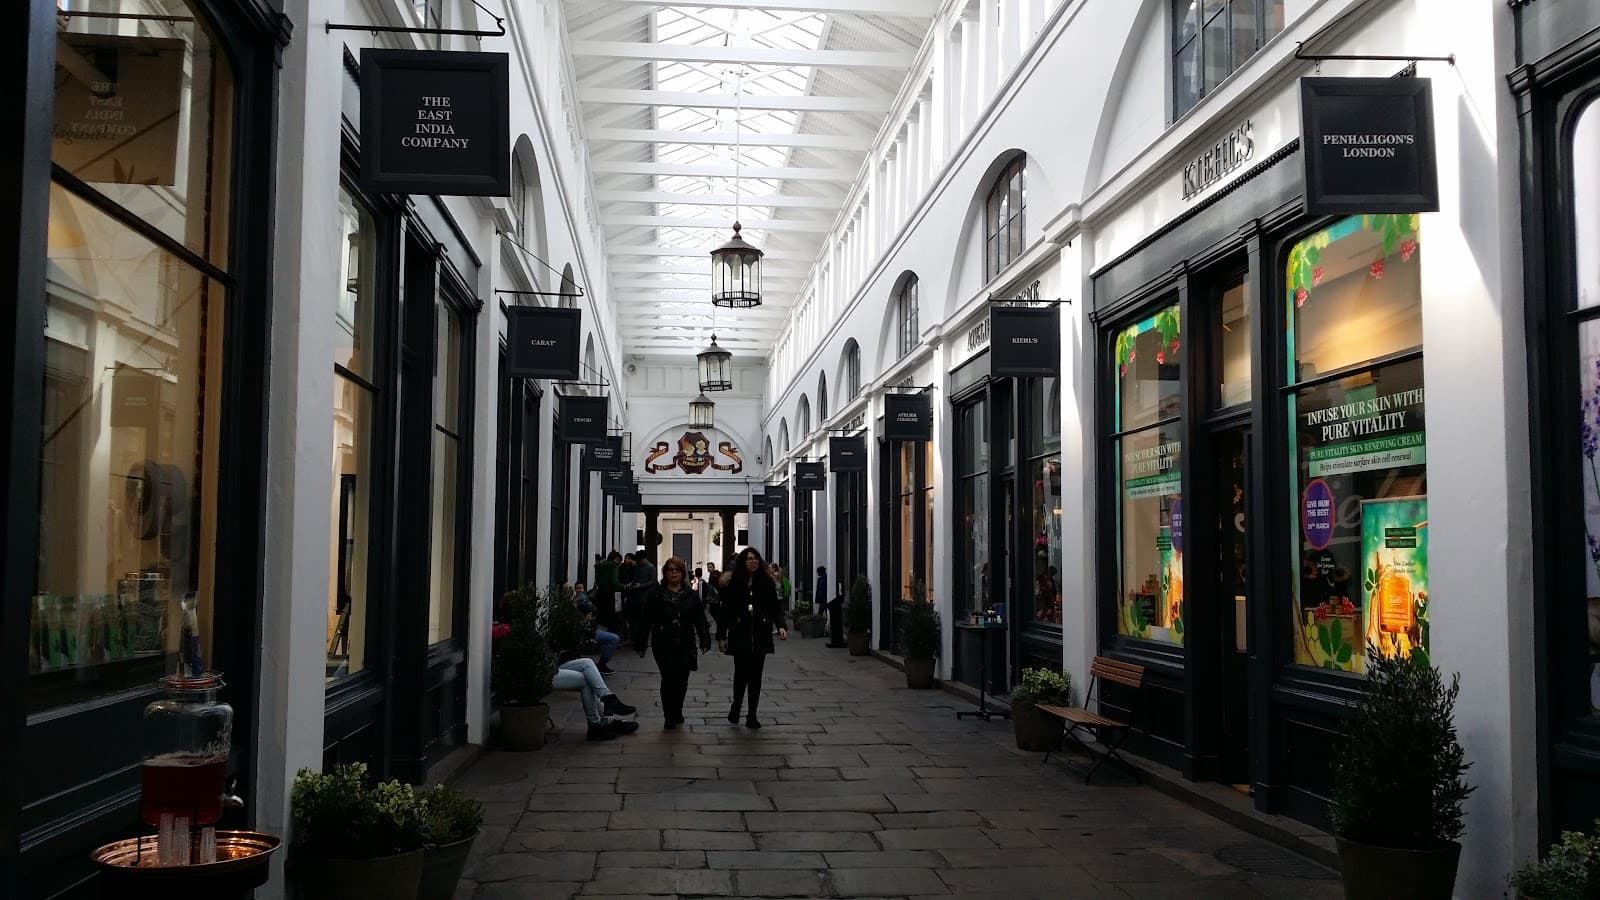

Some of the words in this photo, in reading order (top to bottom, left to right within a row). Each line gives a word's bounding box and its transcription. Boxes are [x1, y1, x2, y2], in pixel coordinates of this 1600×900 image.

[422, 96, 451, 107] THE
[417, 109, 453, 121] EAST
[415, 123, 456, 135] INDIA
[401, 136, 470, 149] COMPANY
[1322, 134, 1415, 145] PENHALIGON'S
[1343, 147, 1396, 158] LONDON
[1307, 406, 1339, 426] INFUSE
[1340, 401, 1365, 419] YOUR
[1367, 395, 1391, 414] SKIN
[1392, 388, 1424, 408] WITH
[1321, 421, 1350, 442] PURE
[1351, 411, 1408, 437] VITALITY
[1310, 450, 1324, 459] PURE
[1325, 446, 1351, 458] VITALITY
[1350, 445, 1364, 454] SKIN
[1364, 439, 1397, 452] RENEWING
[1397, 434, 1423, 447] CREAM
[1371, 455, 1381, 464] skin
[1381, 453, 1391, 463] cell
[1306, 500, 1317, 508] GIVE
[1306, 509, 1317, 517] THE
[1317, 508, 1330, 517] BEST
